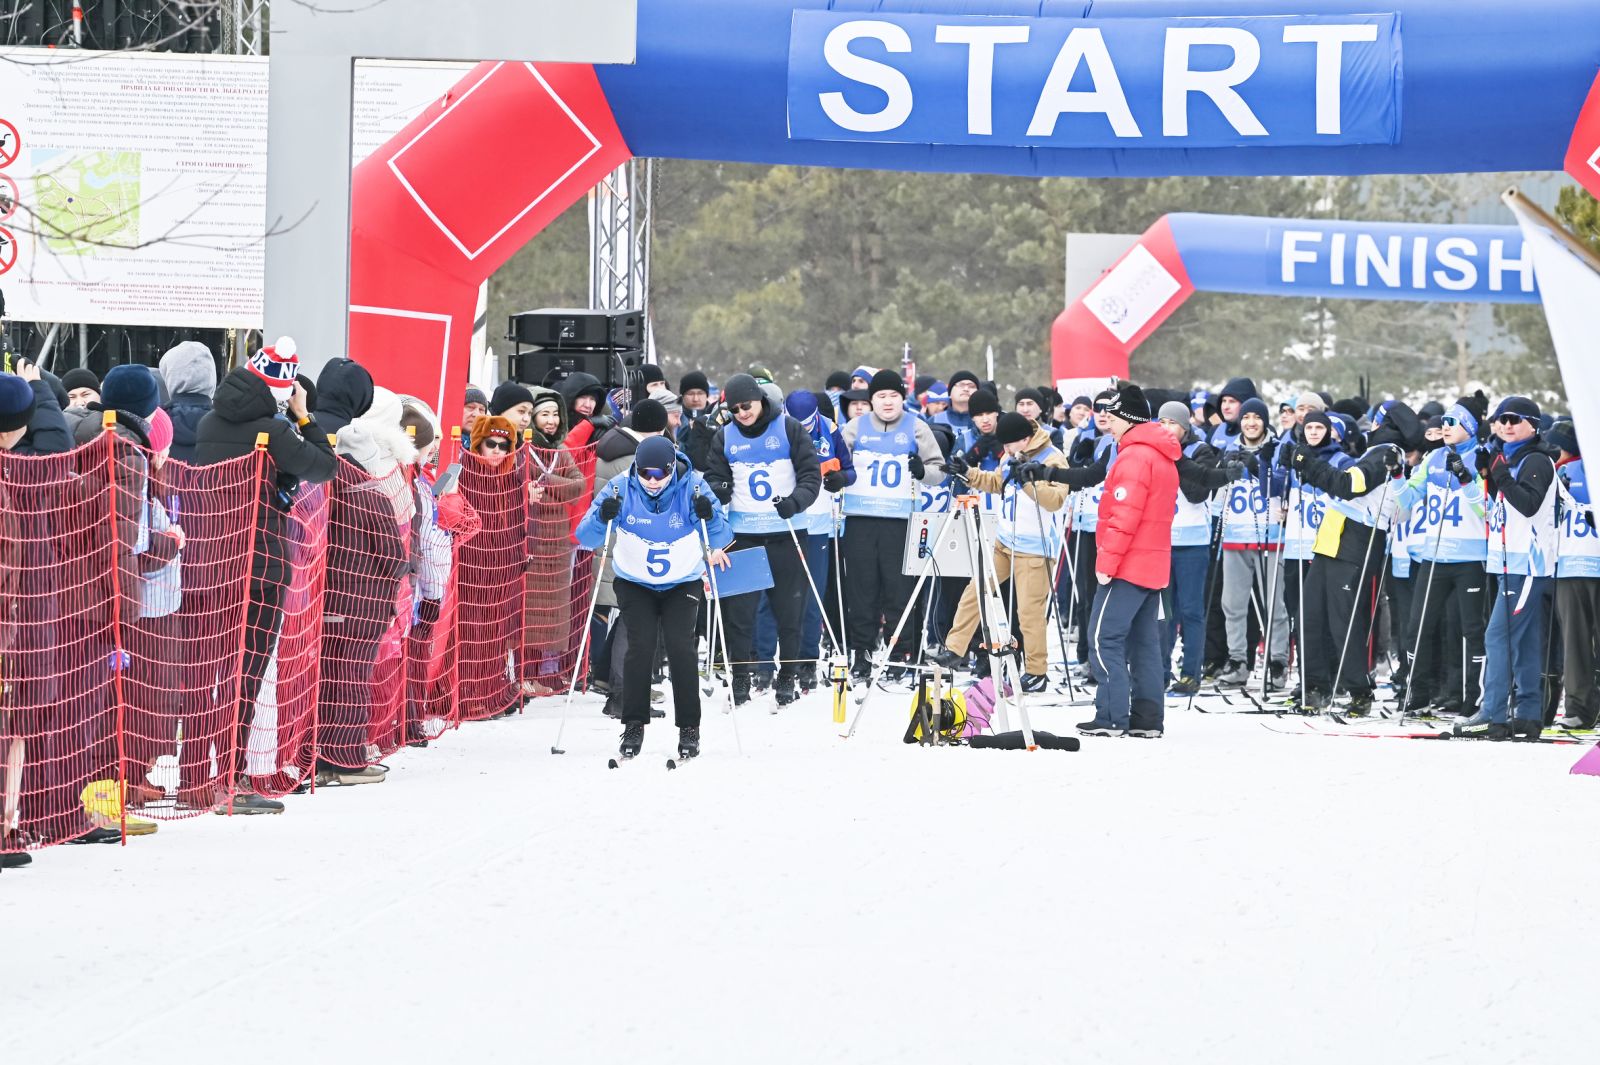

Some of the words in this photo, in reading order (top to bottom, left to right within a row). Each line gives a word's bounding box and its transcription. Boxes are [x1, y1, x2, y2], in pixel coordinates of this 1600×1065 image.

[818, 20, 1378, 138] START
[1280, 230, 1536, 293] FINISH
[748, 469, 773, 502] 6
[866, 459, 902, 489] 10
[1230, 485, 1268, 515] 66
[1294, 499, 1326, 530] 16
[1412, 494, 1463, 534] 284
[1562, 509, 1599, 539] 15
[646, 548, 671, 578] 5
